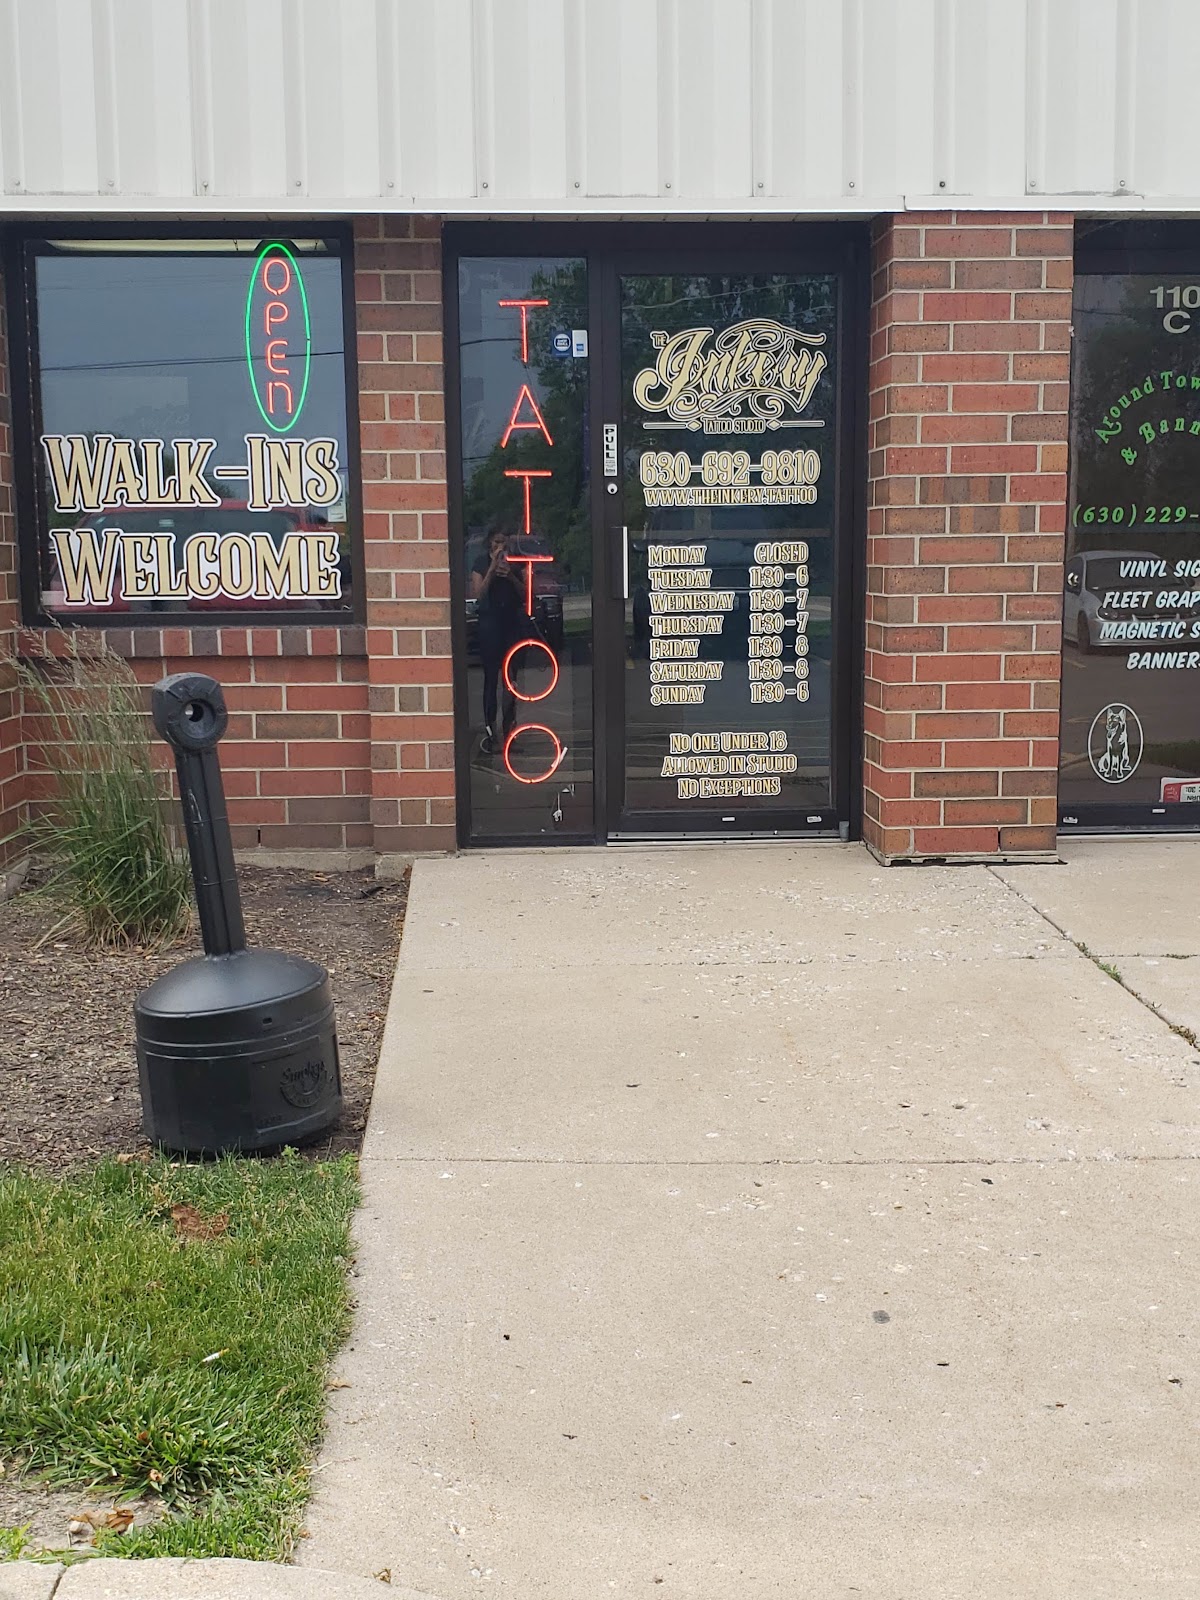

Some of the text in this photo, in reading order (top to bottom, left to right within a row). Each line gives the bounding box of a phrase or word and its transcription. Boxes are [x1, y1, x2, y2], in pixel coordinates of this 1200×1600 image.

[1150, 286, 1200, 308] 110
[1163, 311, 1190, 333] C
[262, 258, 293, 414] OPEN
[652, 332, 669, 348] THE
[633, 319, 827, 421] Inkery
[1095, 376, 1154, 444] Around
[702, 417, 766, 434] TATTOO STUDIO
[605, 428, 615, 459] PULL
[1121, 418, 1200, 466] & Bann
[42, 435, 341, 511] WALK-INS
[640, 450, 821, 486] 630-692-9810
[644, 487, 817, 506] WWW.THEINKERY.TATTOO
[1072, 504, 1199, 527] (630) 229-
[498, 299, 561, 784] TATTOO
[648, 542, 809, 567] MONDAY CLOSED
[50, 529, 342, 605] WELCOME
[1120, 560, 1200, 578] VINYL SIG
[648, 568, 712, 591] TUESDAY
[649, 592, 735, 614] WEDNESDAY
[1102, 591, 1200, 609] FLEET GRAP
[649, 615, 725, 637] THURSDAY
[1100, 621, 1187, 640] MAGNETIC
[650, 638, 700, 660] FRIDAY
[1126, 651, 1200, 670] BANNER
[650, 661, 724, 683] SATURDAY
[650, 684, 706, 706] SUNDAY
[670, 731, 787, 754] NO ONE UNDER 18
[661, 754, 798, 777] ALLOWED IN STUDIO
[678, 777, 781, 798] NO EXCEPTIONS
